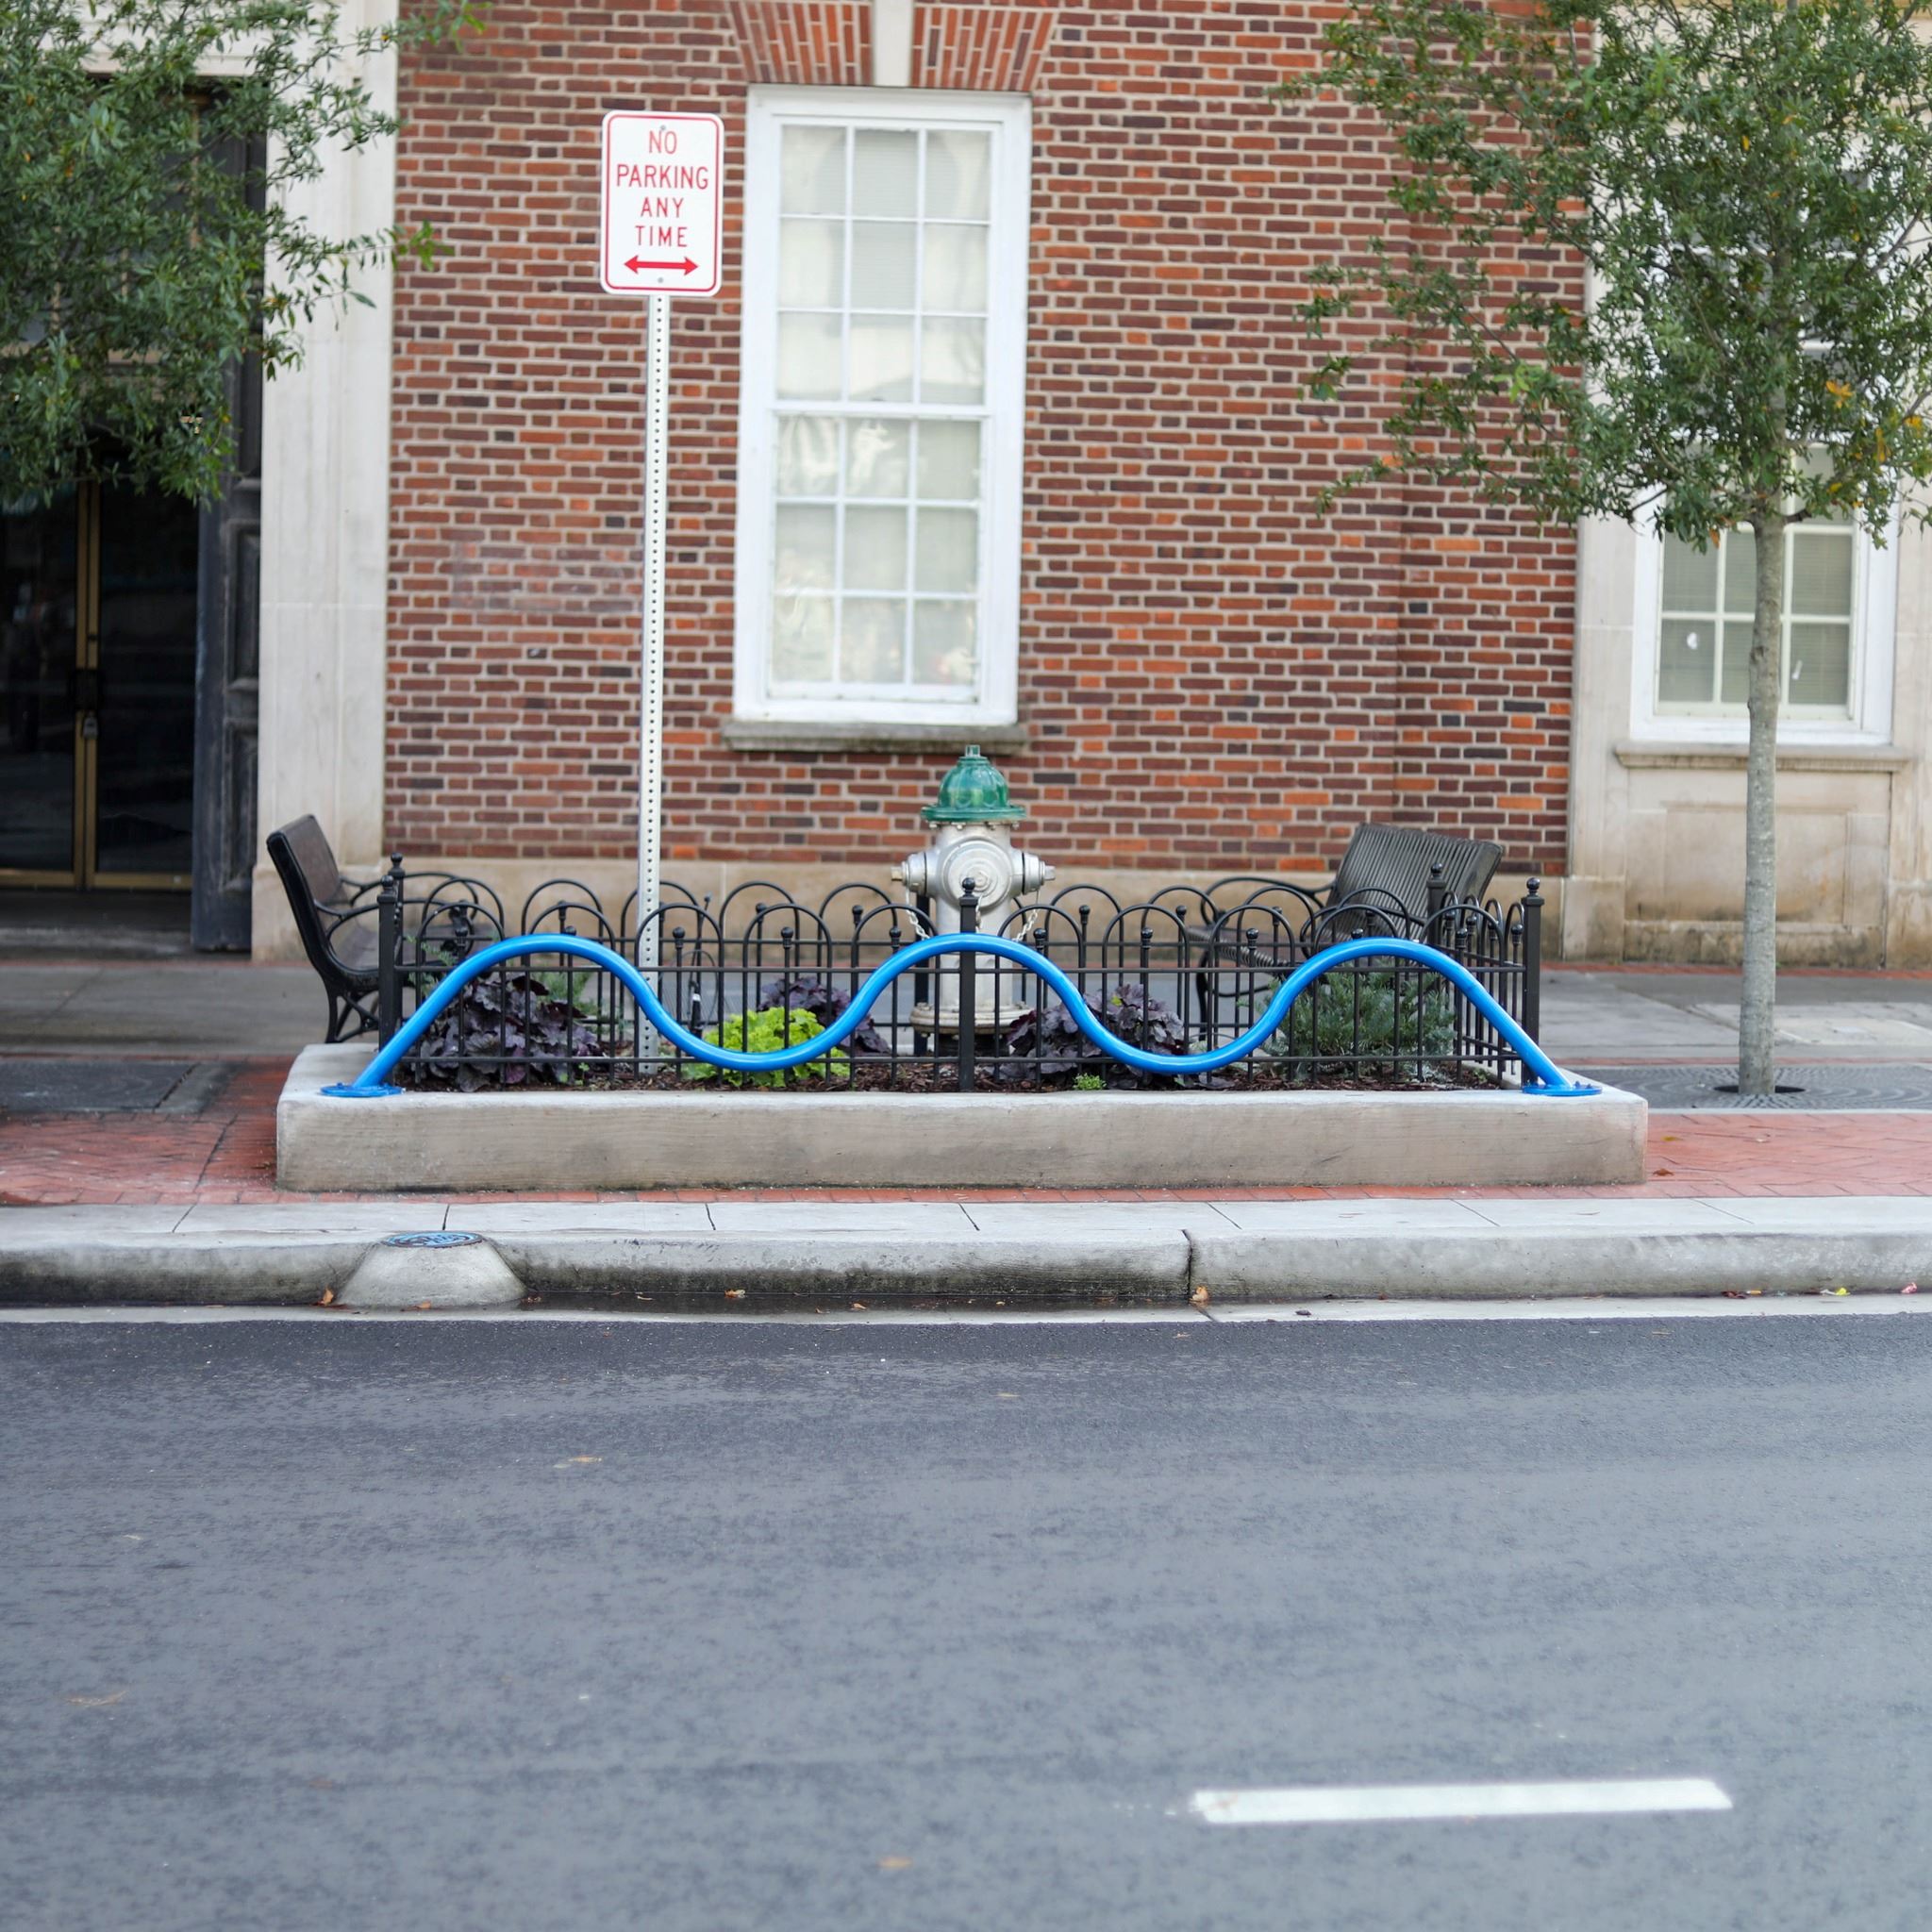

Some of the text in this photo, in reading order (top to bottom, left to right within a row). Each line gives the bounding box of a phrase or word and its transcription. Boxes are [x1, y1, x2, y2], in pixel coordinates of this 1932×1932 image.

[648, 130, 677, 155] NO
[616, 163, 708, 190] PARKING
[641, 196, 684, 218] ANY
[635, 225, 688, 247] TIME
